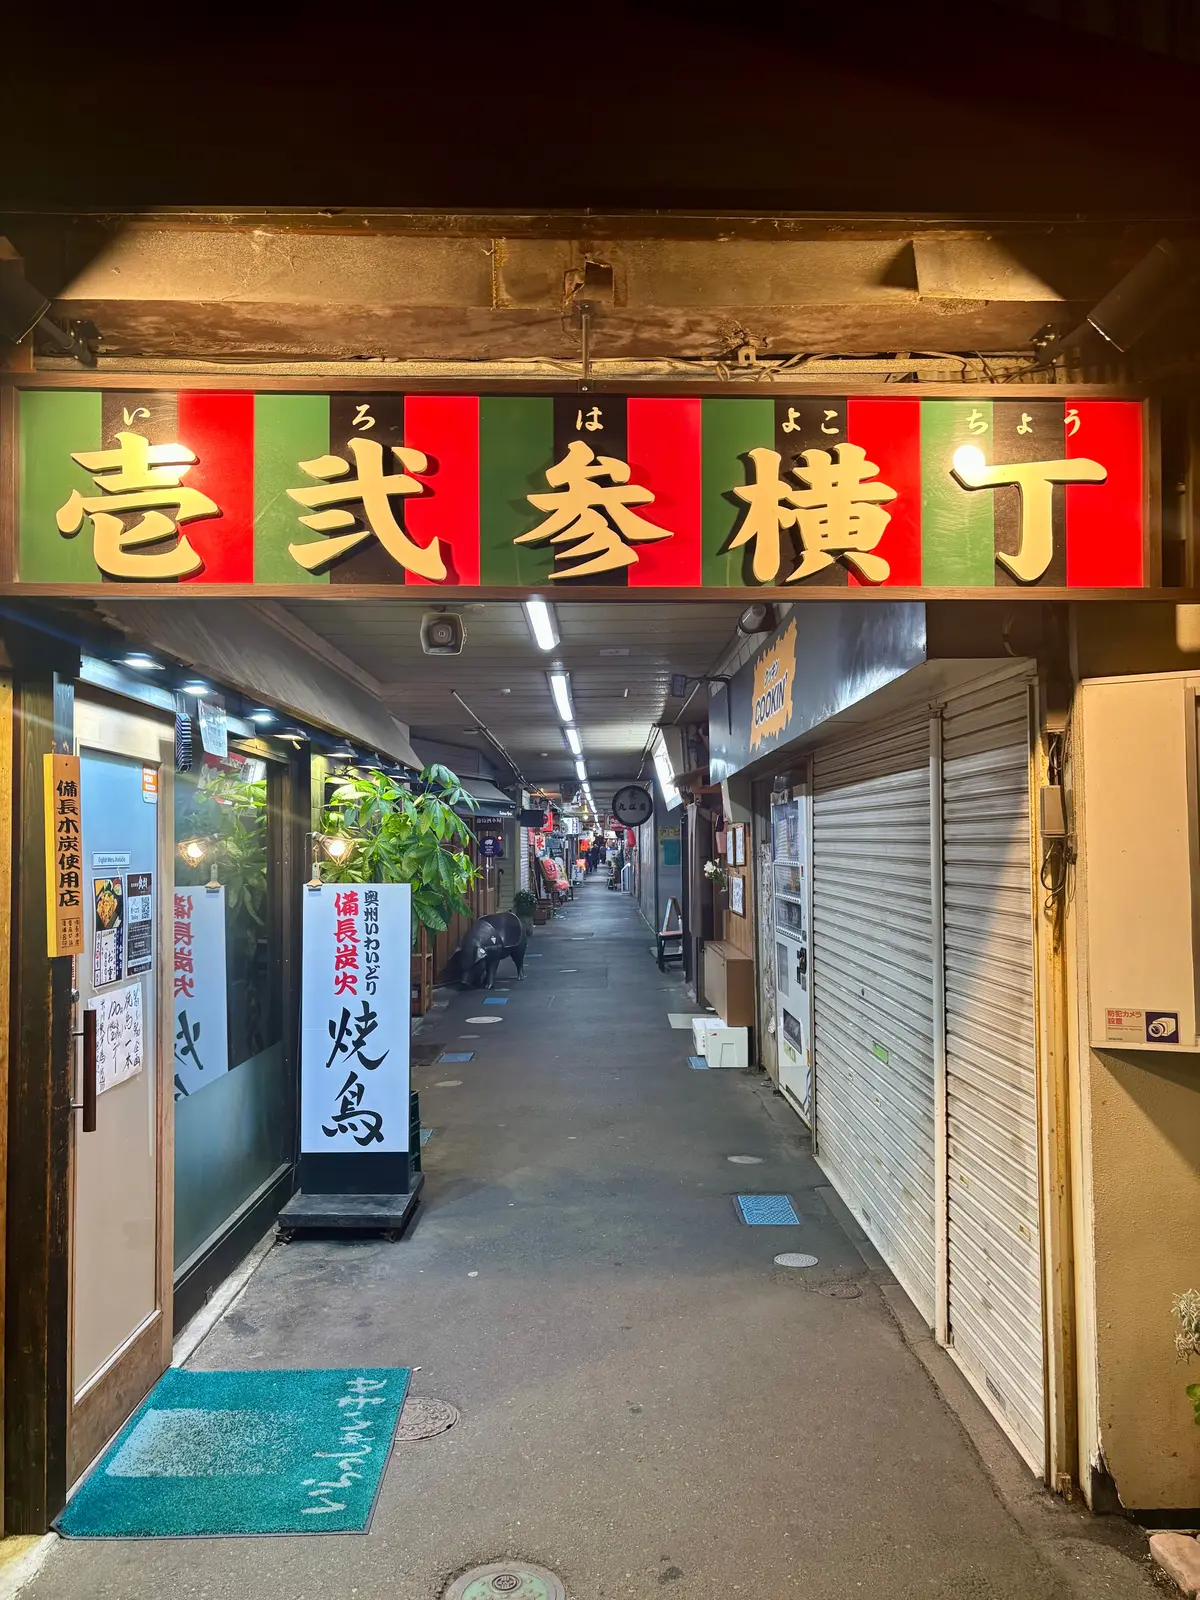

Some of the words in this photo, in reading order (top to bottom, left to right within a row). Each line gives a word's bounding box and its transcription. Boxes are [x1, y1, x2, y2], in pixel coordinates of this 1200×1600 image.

[56, 431, 1108, 584] 壱弐参横丁
[56, 779, 82, 908] 備長木炭使用店
[333, 890, 361, 996] 備長炭火
[363, 890, 381, 996] 奥州いわいどり
[1107, 1010, 1142, 1018] 防犯カメラ
[321, 1000, 390, 1147] 焼鳥
